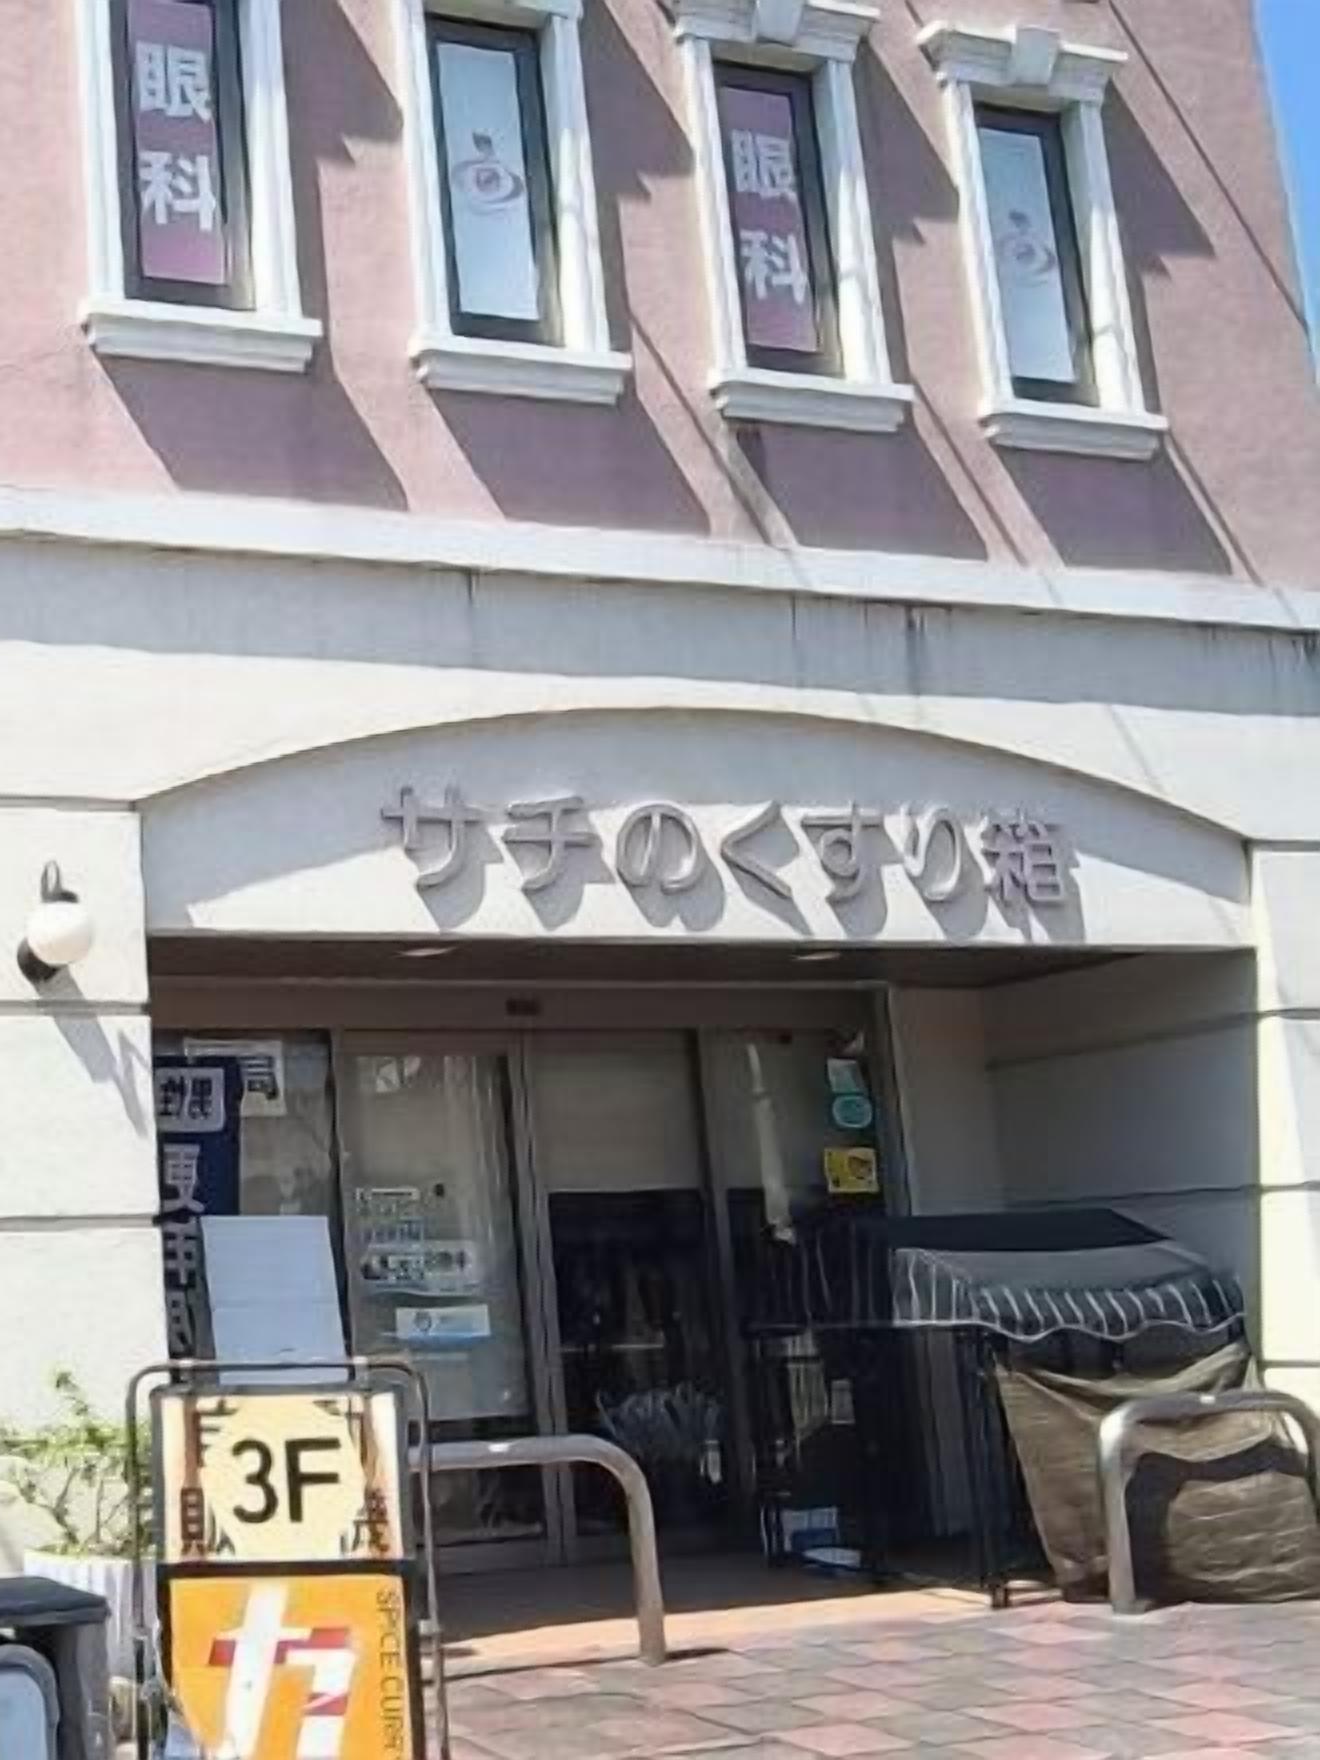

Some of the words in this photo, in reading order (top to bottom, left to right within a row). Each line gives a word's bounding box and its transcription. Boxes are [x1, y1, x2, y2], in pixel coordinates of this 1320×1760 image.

[136, 40, 216, 231] 眼科
[732, 128, 808, 304] 眼科
[381, 785, 1068, 904] サチのくすり箱
[231, 1436, 342, 1524] 3F
